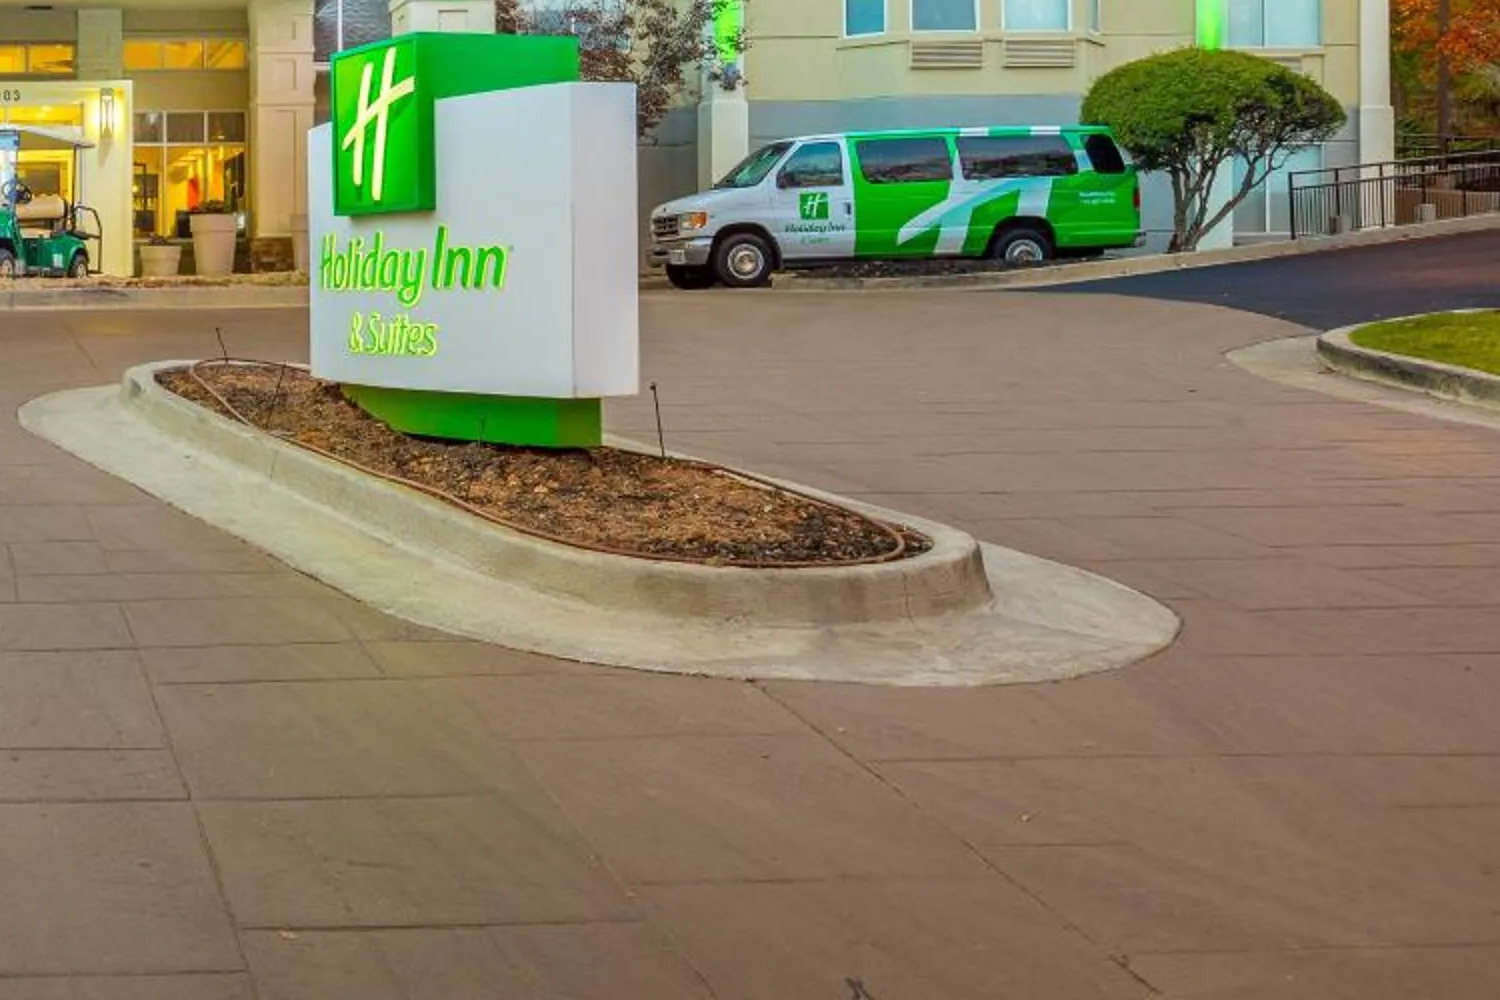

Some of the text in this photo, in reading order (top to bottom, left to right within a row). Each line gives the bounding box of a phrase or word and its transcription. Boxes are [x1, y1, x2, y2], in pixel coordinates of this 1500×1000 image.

[319, 223, 508, 308] Holiday Inn
[348, 311, 438, 357] & Suites
